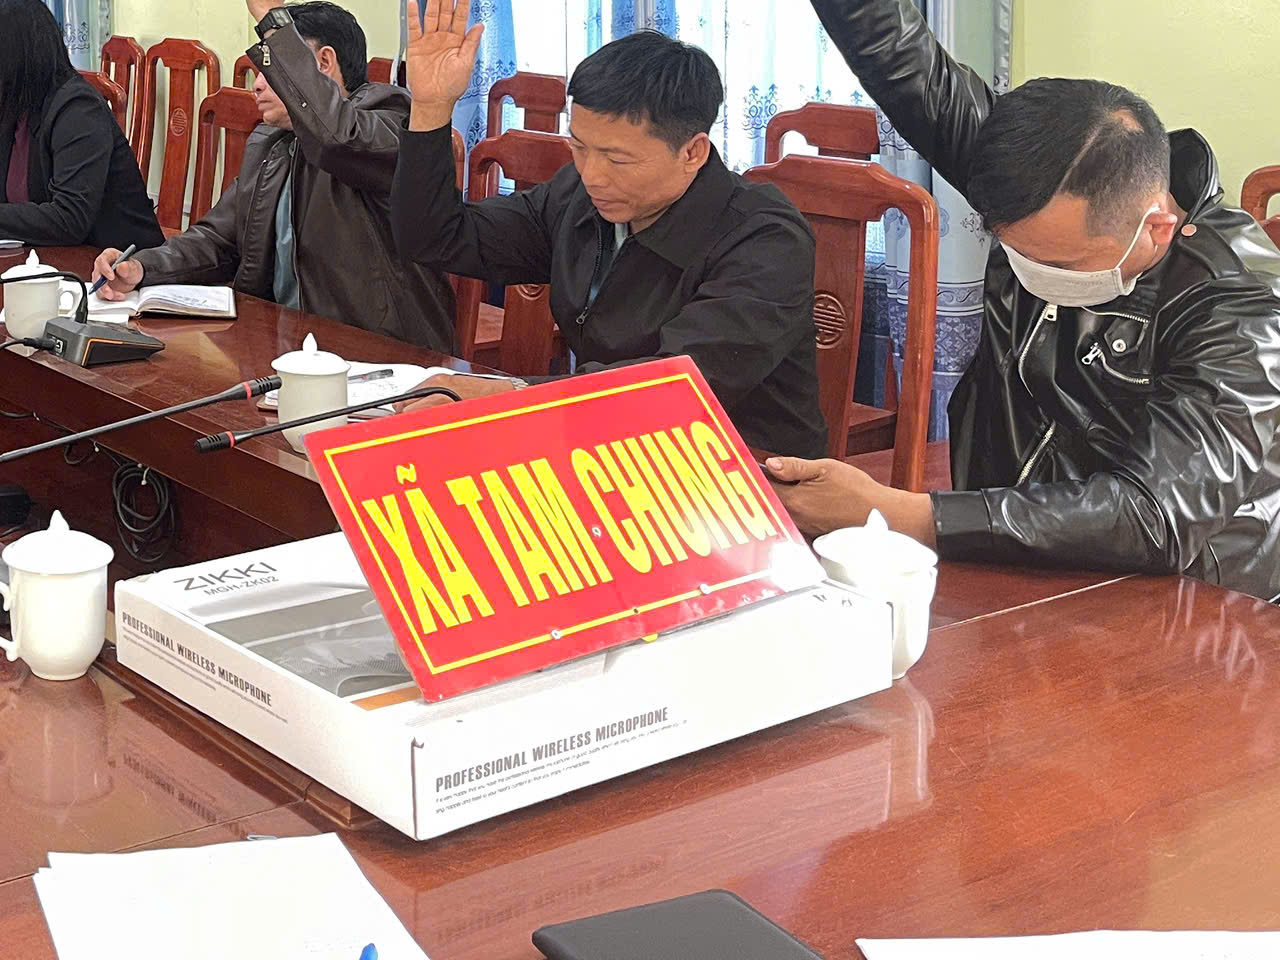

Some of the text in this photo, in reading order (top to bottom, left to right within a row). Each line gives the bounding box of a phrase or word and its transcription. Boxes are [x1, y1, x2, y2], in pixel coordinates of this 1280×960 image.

[361, 420, 778, 635] XÃ TAM CHUNG
[173, 562, 277, 591] ZIKKI
[122, 611, 175, 652] PROFESSIONAL
[177, 644, 216, 676] WIRELESS
[218, 665, 273, 707] MICROPHONE
[435, 751, 528, 793] PROFESSIONAL
[532, 730, 592, 762] WIRELESS
[595, 706, 669, 743] MICROPHONE
